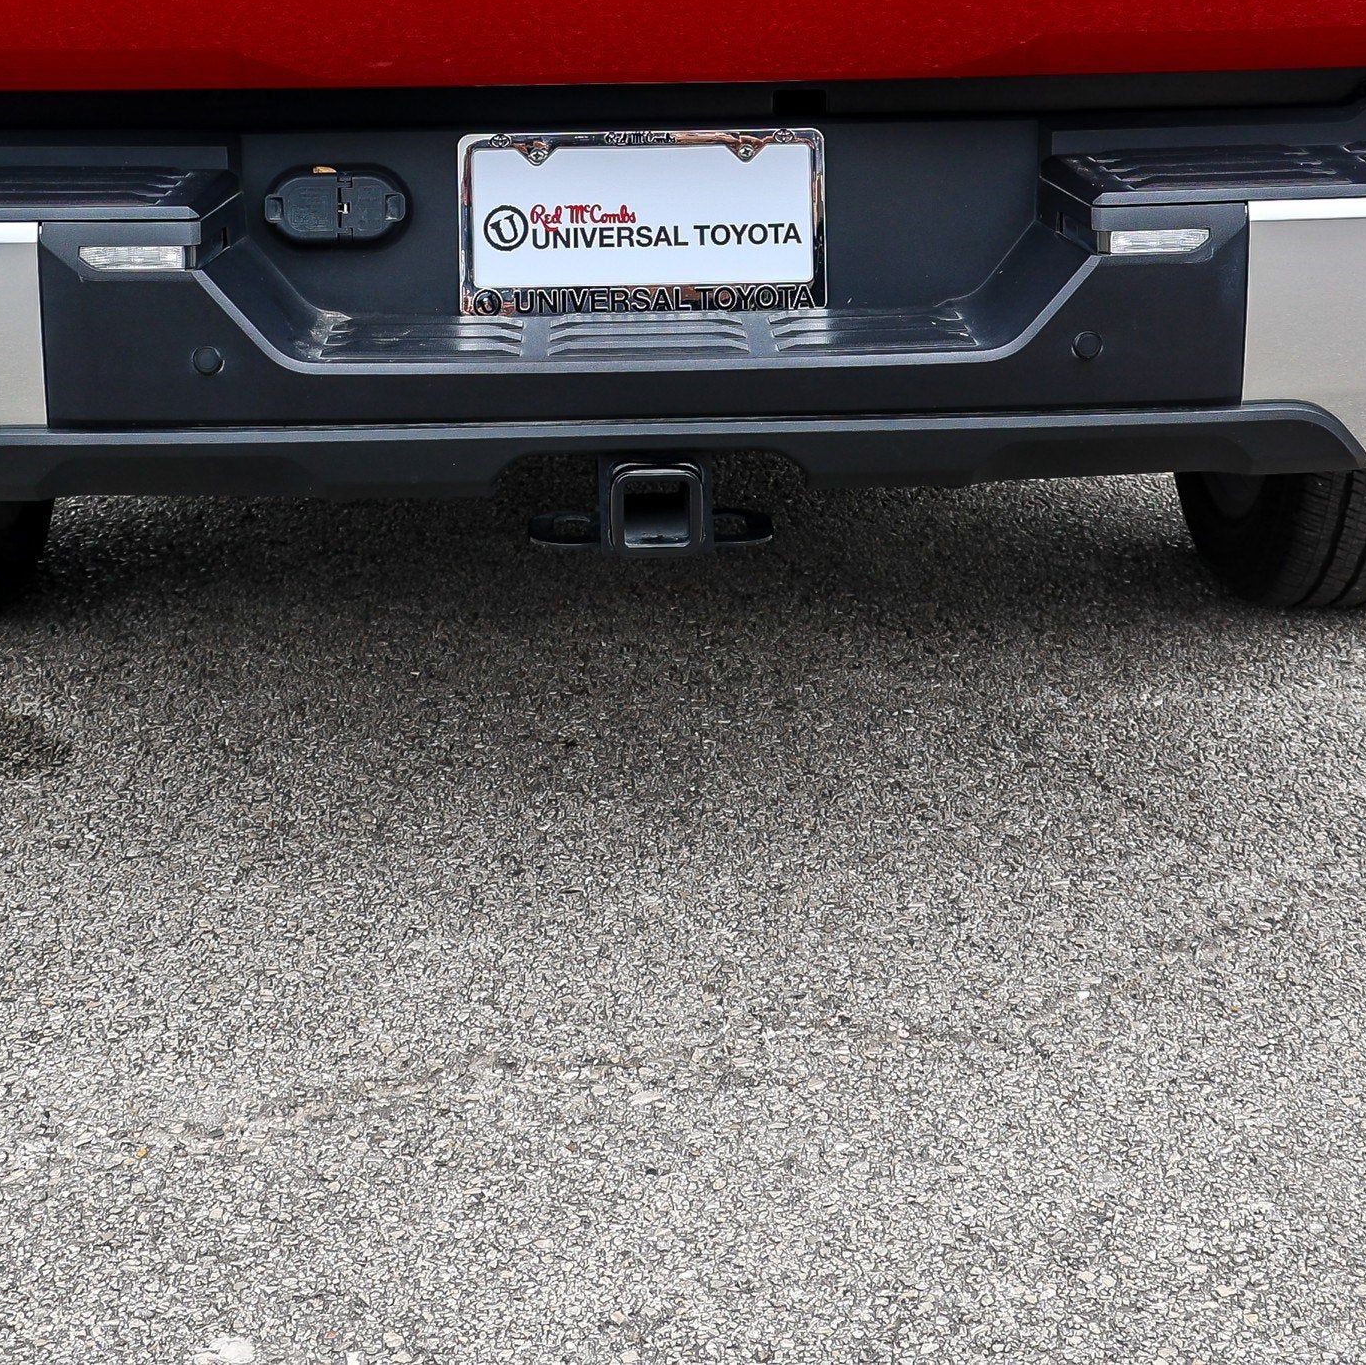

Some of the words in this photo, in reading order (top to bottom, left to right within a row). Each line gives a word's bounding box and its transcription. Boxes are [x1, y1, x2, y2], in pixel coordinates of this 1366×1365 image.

[604, 131, 627, 147] Red
[530, 204, 562, 231] Red
[564, 204, 636, 224] McCombs
[532, 226, 688, 250] UNIVERSAL
[693, 222, 802, 246] TOYOTA
[513, 286, 692, 314] UNIVERSAL
[694, 283, 816, 312] TOYOTA
